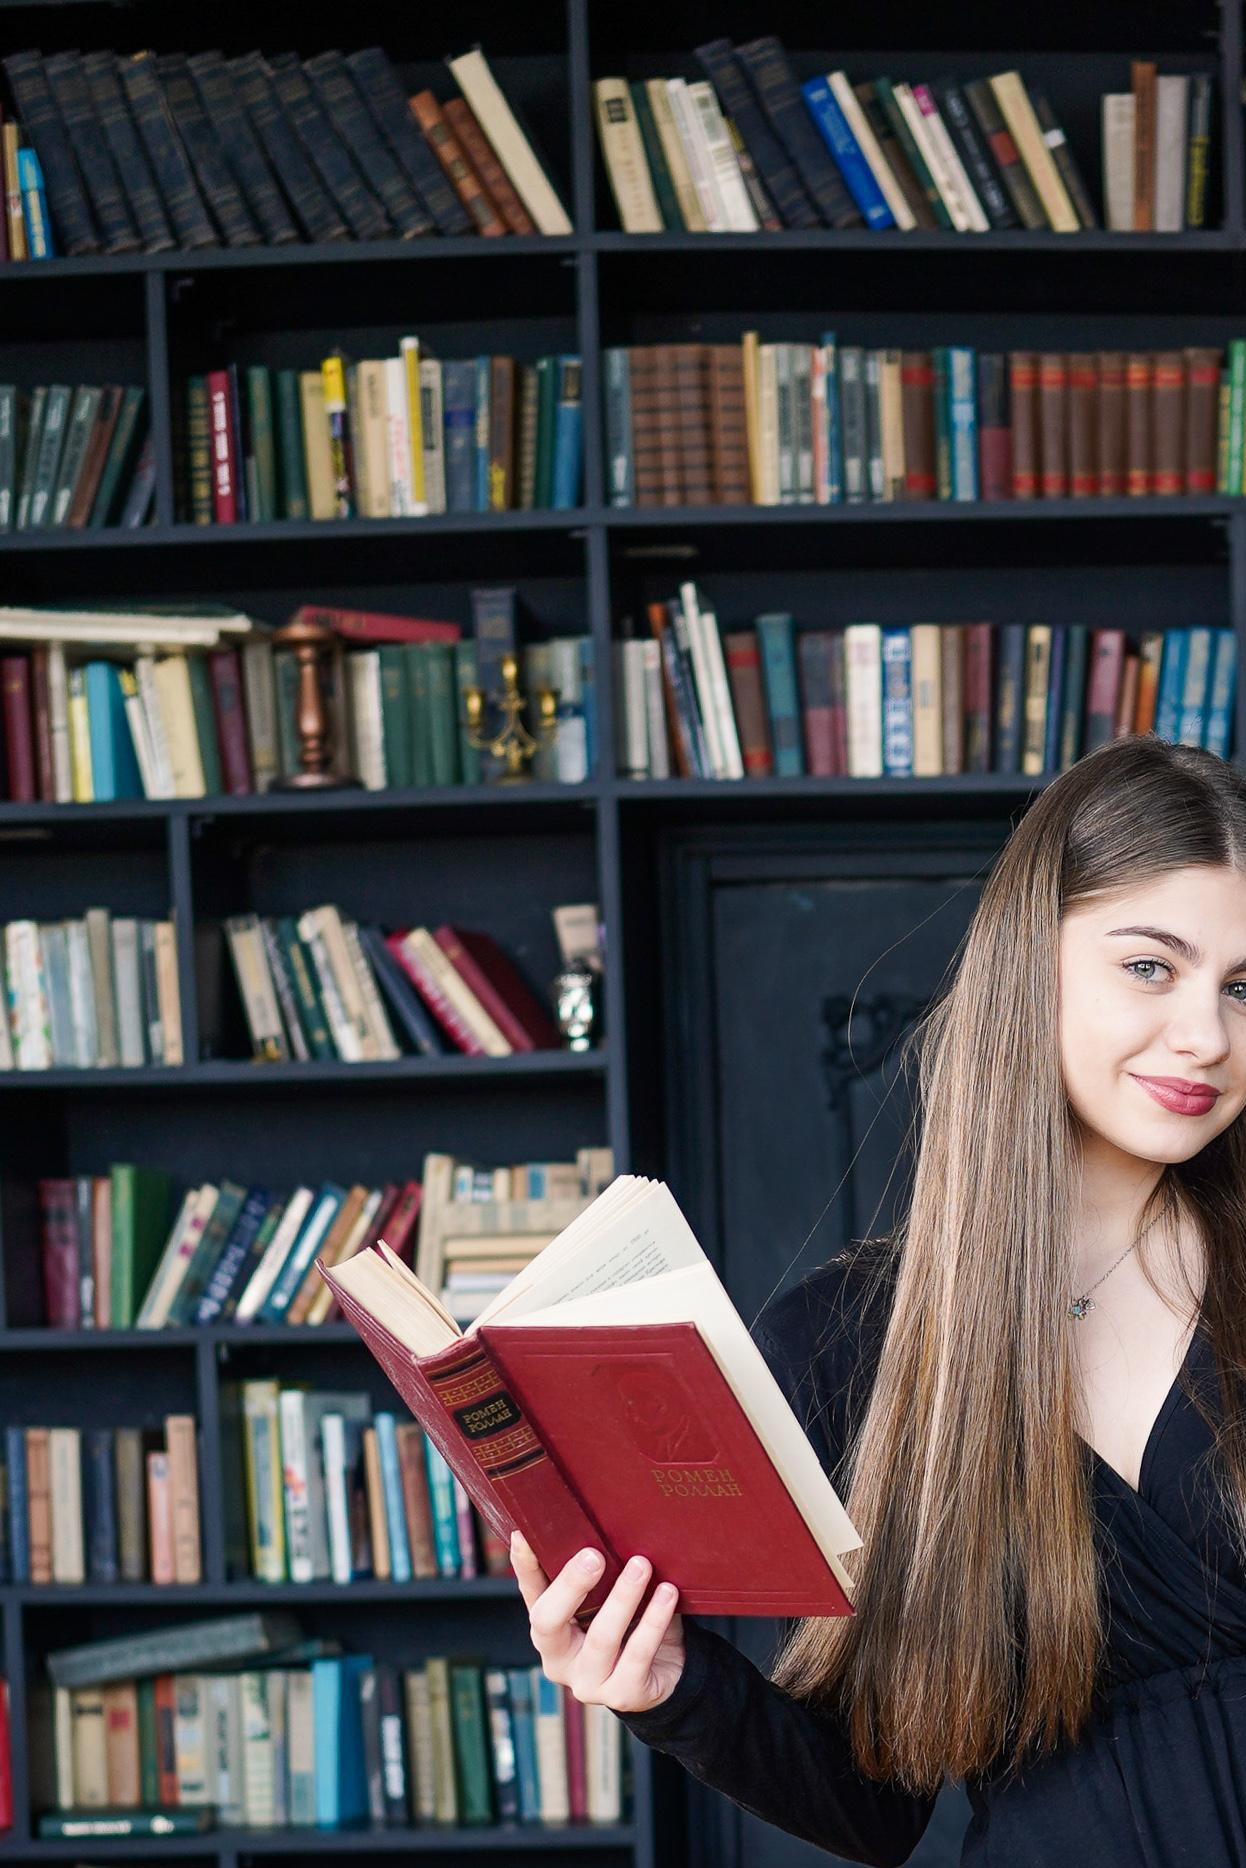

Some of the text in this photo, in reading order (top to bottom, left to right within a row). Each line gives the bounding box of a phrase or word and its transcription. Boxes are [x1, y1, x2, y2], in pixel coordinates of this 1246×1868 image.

[462, 1399, 506, 1423] РОМЕН
[468, 1408, 512, 1433] РОЛЛАН
[651, 1469, 735, 1483] РОМЕН
[657, 1483, 743, 1497] РОЛЛАН
